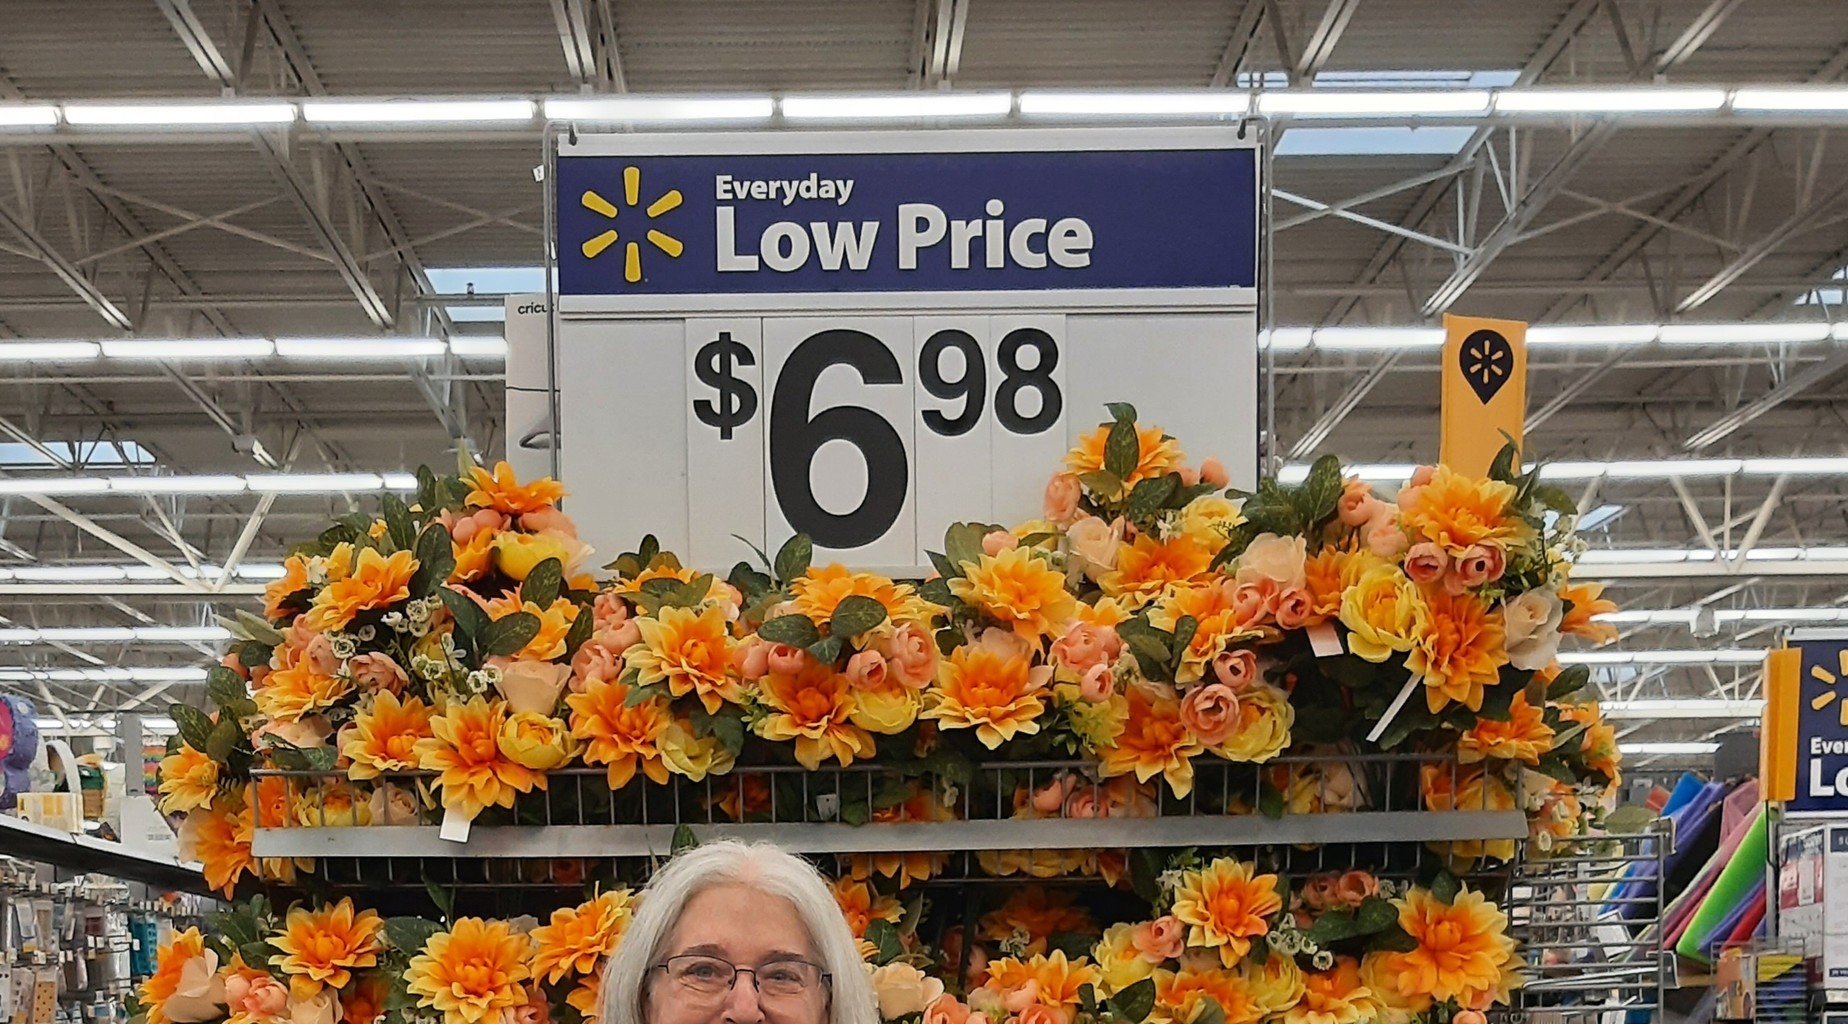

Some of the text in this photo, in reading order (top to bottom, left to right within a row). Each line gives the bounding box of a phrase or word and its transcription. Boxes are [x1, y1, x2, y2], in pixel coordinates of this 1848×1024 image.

[716, 173, 854, 206] Everyday
[716, 198, 1094, 272] Low Price
[517, 301, 554, 315] cricu
